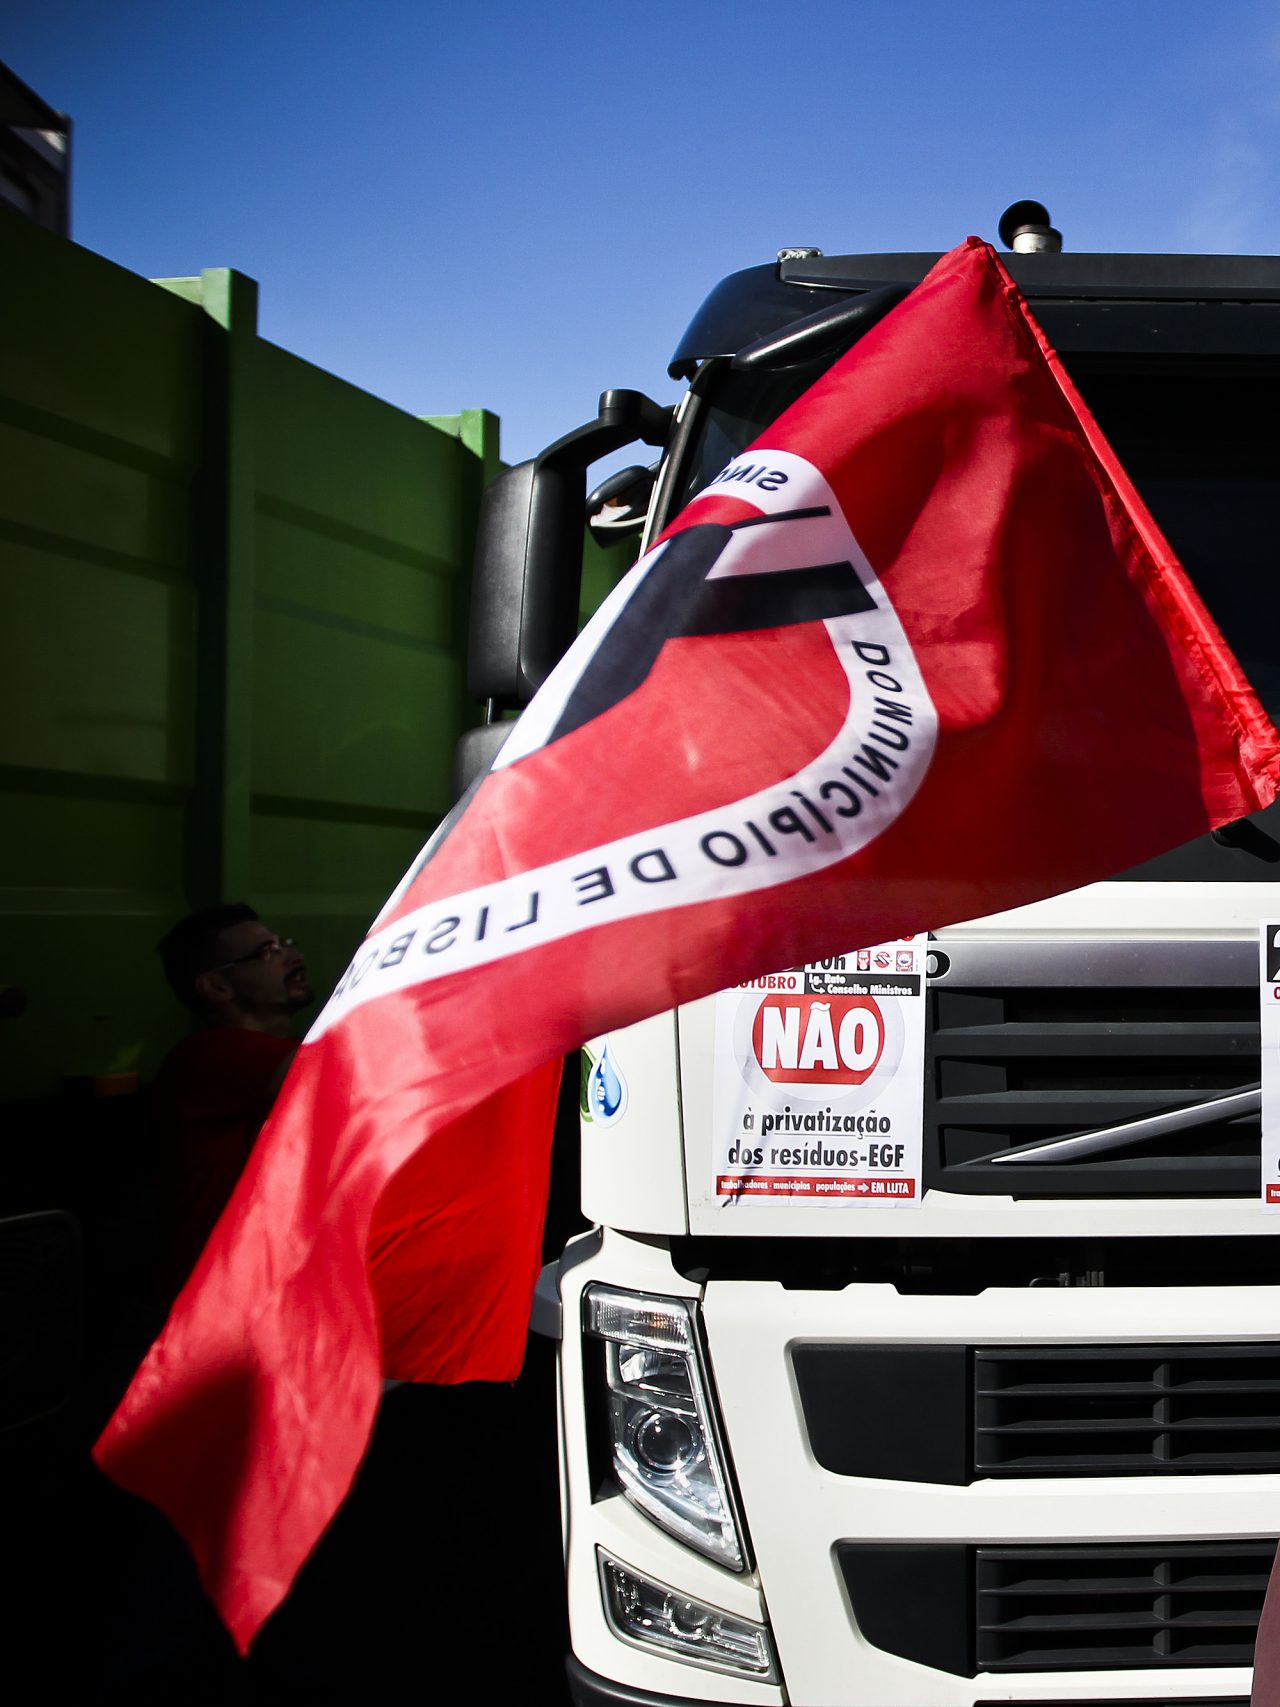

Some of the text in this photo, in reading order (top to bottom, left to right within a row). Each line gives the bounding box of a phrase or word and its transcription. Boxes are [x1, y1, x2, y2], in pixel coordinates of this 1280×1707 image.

[808, 973, 846, 986] Lg. Rato
[827, 984, 912, 996] Conselho Ministros
[761, 1001, 880, 1072] NÃO
[743, 1106, 891, 1140] à privatização
[728, 1139, 905, 1167] dos resíduos-EGF
[773, 1181, 811, 1191] municípios
[815, 1182, 855, 1193] populações
[871, 1183, 885, 1194] EM
[887, 1183, 909, 1194] LUTA
